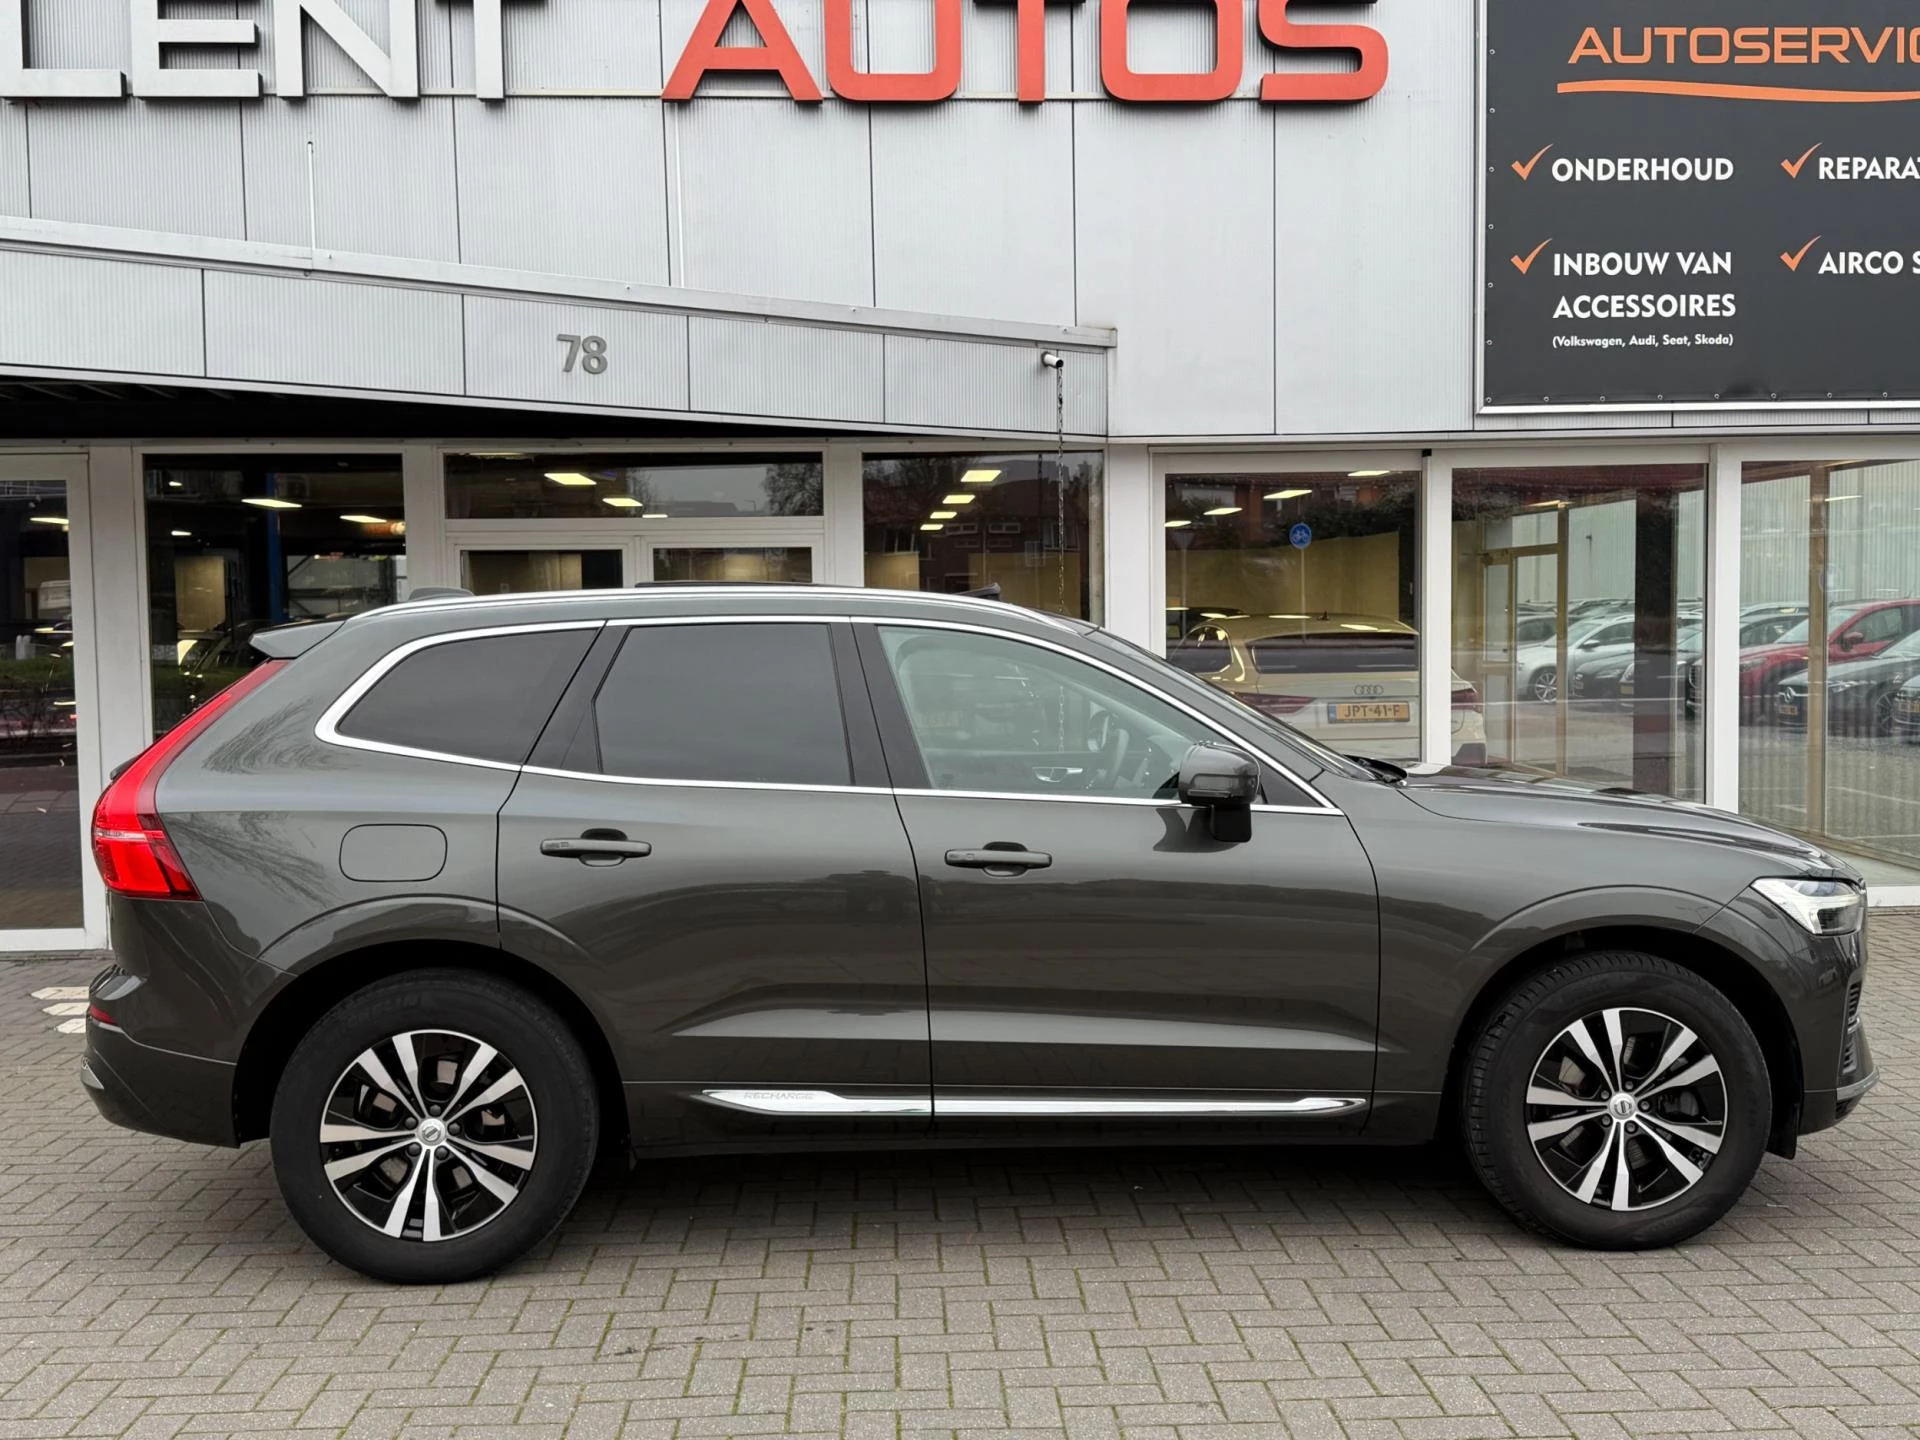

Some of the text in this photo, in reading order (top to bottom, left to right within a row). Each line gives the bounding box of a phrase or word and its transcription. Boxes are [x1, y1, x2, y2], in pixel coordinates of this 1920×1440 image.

[661, 0, 1389, 103] AUTOS
[1567, 26, 1920, 64] AUTOSERVI
[1551, 157, 1734, 182] ONDERHOUD
[1818, 156, 1920, 180] REPARA
[1553, 251, 1732, 277] INBOUW VAN
[1818, 250, 1904, 275] AIRCO
[1552, 293, 1737, 319] ACCESSOIRES
[556, 333, 608, 375] 78
[1552, 333, 1734, 349] (Volkswagen, Audi, Seat, Skoda)
